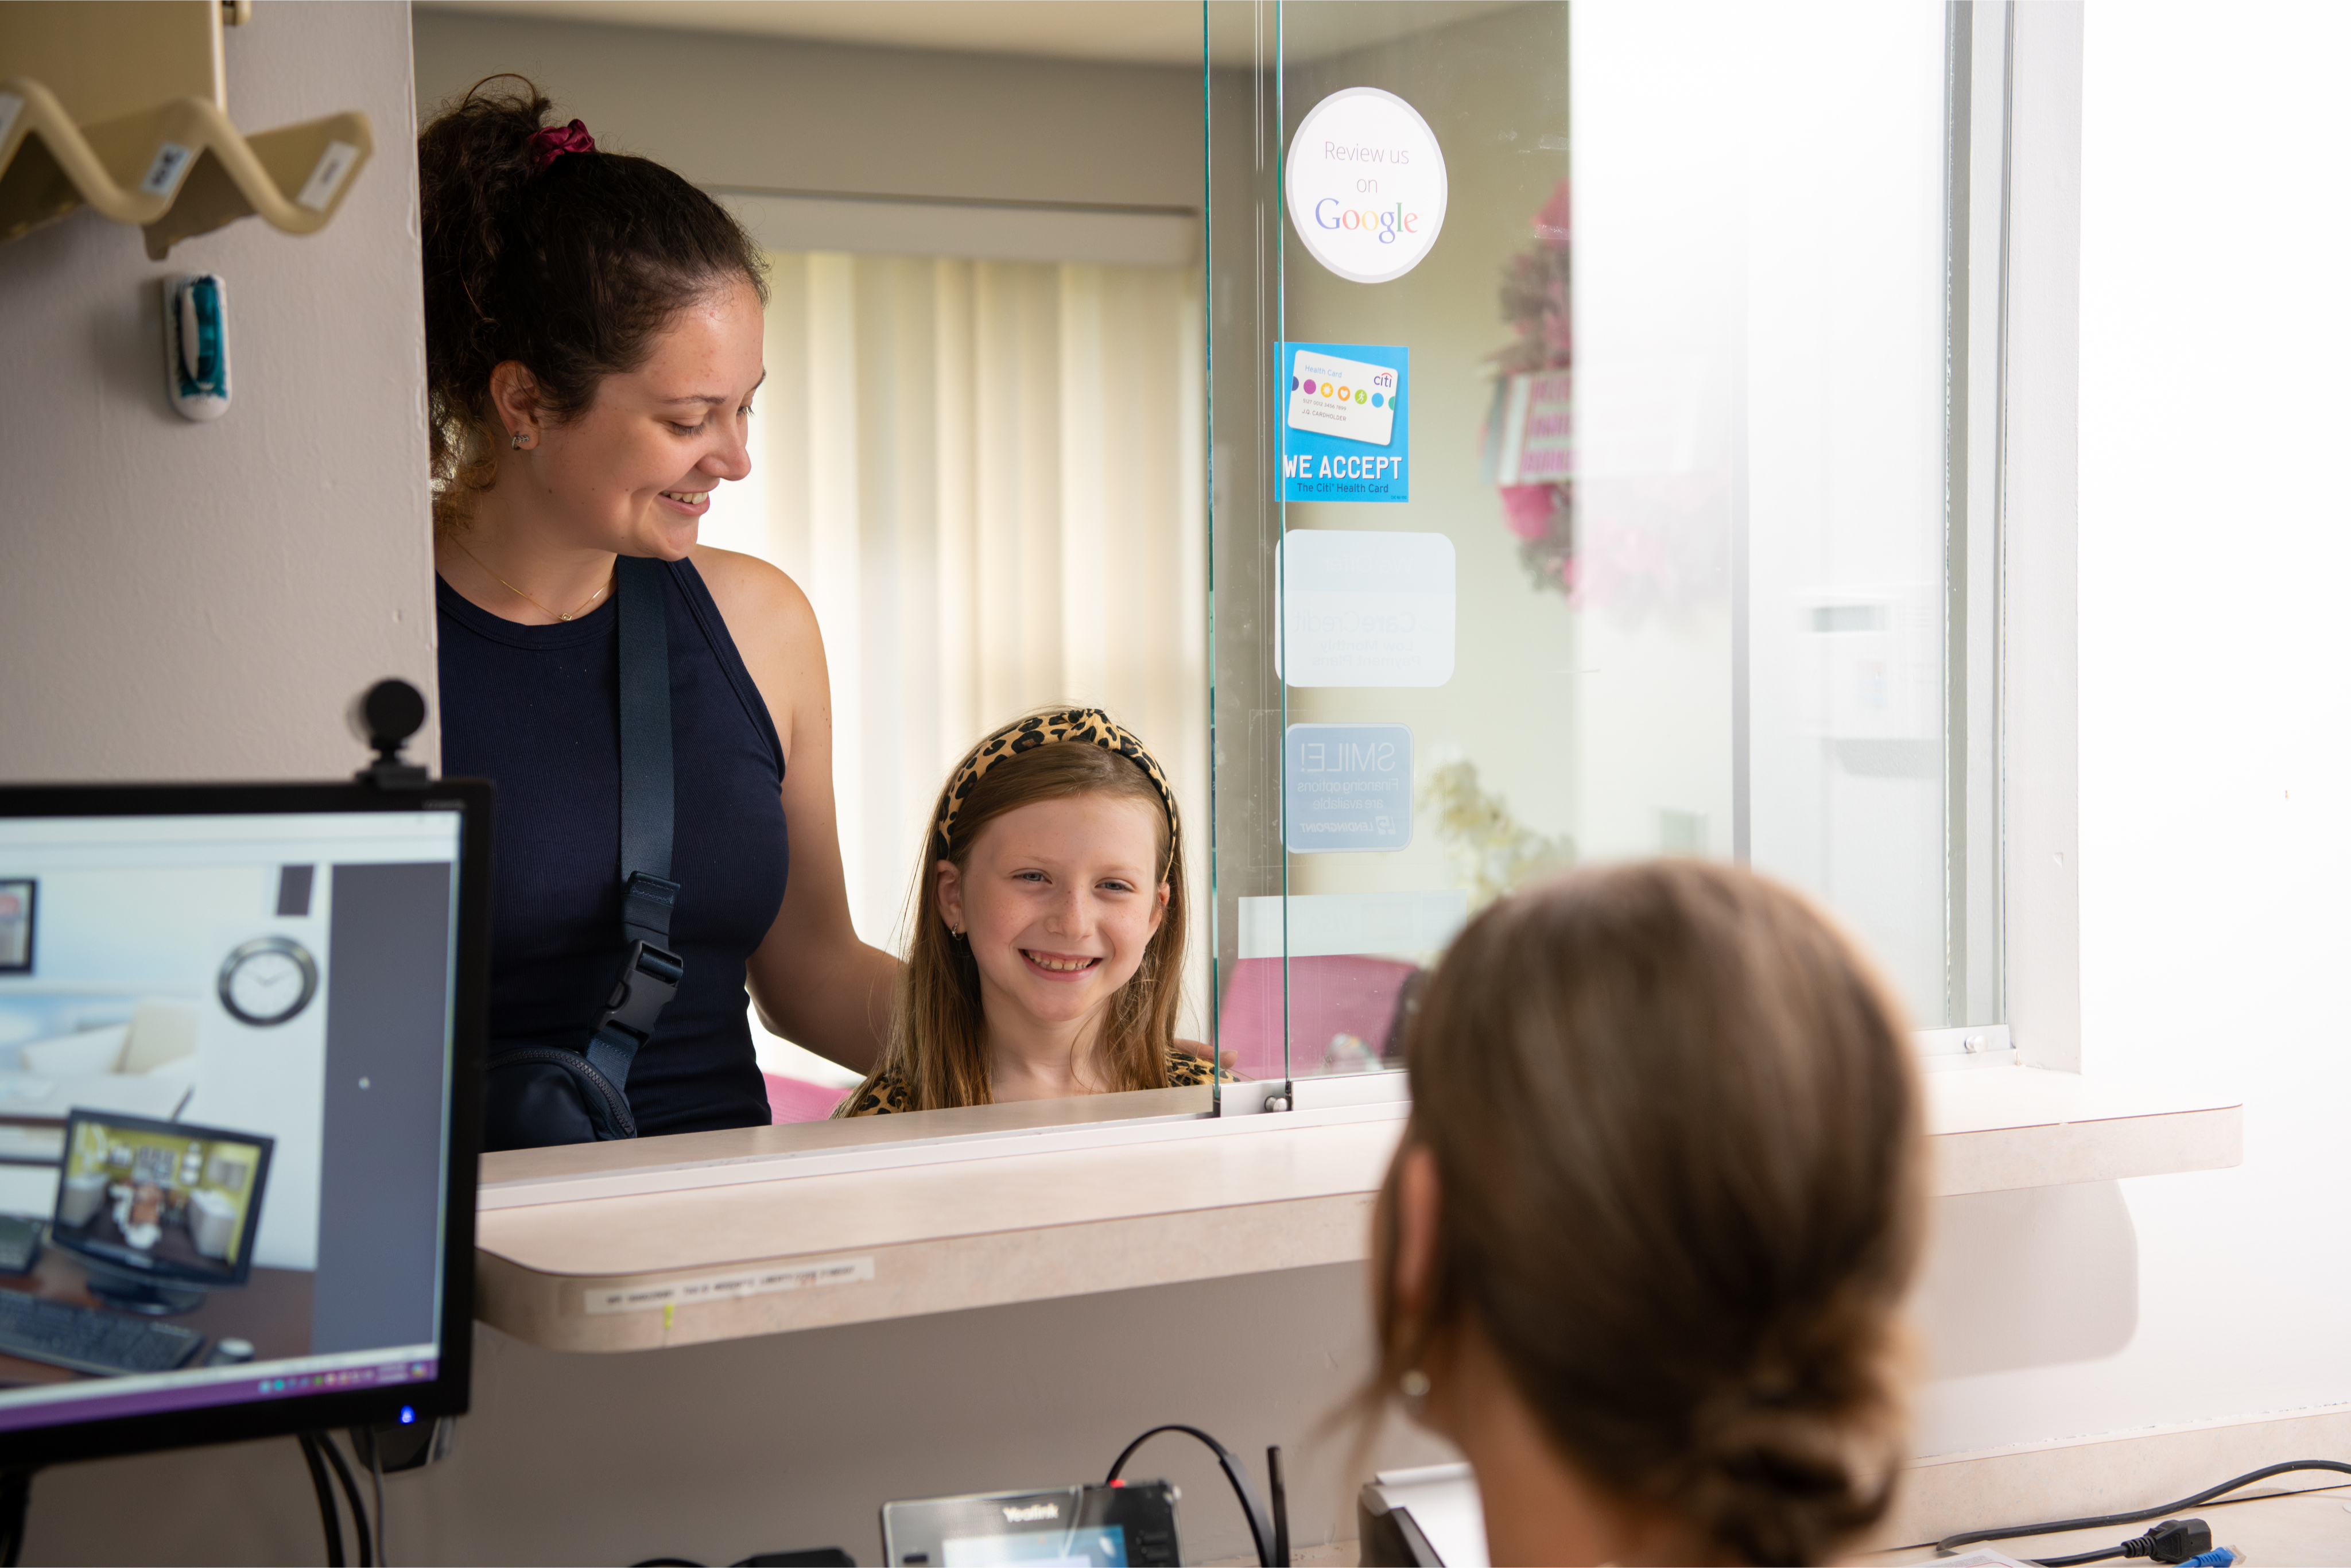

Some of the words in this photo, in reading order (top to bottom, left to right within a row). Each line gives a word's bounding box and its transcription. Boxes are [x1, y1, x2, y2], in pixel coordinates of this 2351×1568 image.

[1325, 141, 1384, 163] Review
[1390, 149, 1409, 164] us
[1356, 178, 1378, 193] on
[1315, 197, 1418, 244] Google
[1305, 364, 1326, 375] Health
[1327, 369, 1342, 378] Card
[1374, 373, 1392, 388] citi
[1312, 410, 1347, 422] CARDHOLDER
[1284, 455, 1313, 479] WE
[1319, 455, 1402, 480] ACCEPT
[1297, 483, 1313, 492] The
[1337, 483, 1365, 492] Health
[1368, 484, 1388, 493] Card
[1002, 1503, 1060, 1523] Yealink
